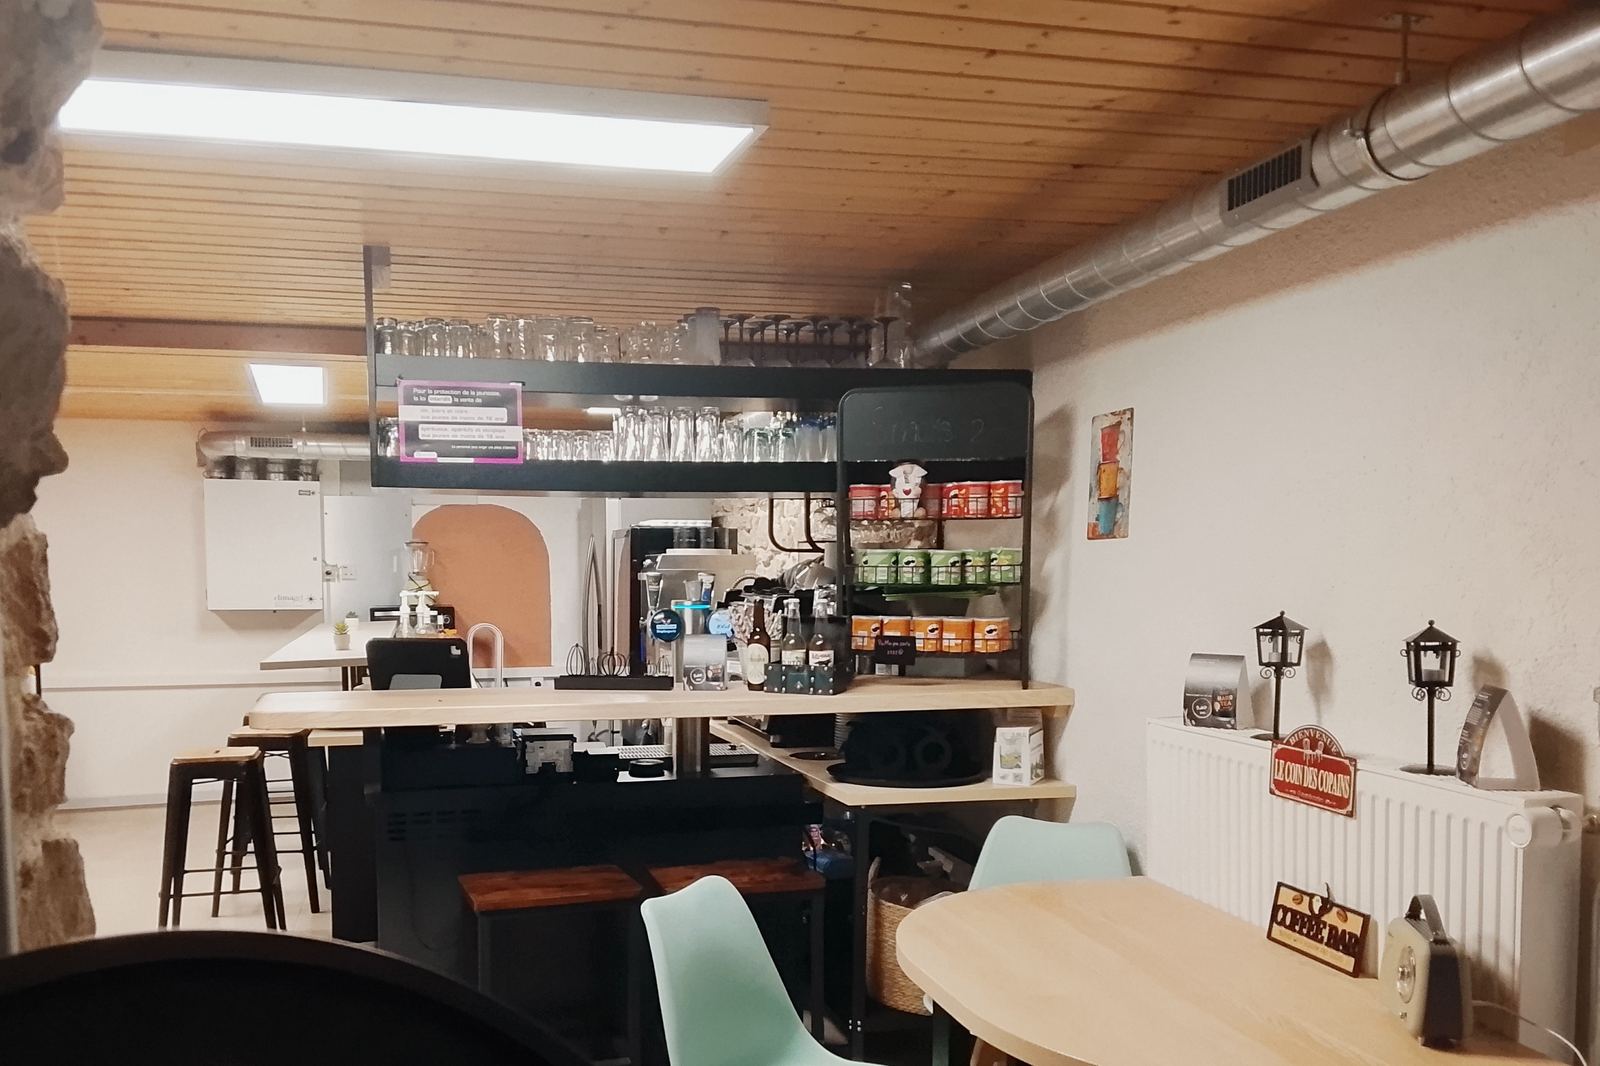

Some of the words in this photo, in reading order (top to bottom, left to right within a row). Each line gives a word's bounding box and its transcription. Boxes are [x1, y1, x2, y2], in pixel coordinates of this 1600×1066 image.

[1289, 729, 1339, 755] BIENVENUE
[1274, 758, 1284, 781] LE
[1285, 761, 1303, 786] COIN
[1303, 765, 1318, 790] DES
[1318, 769, 1350, 799] COPAINS
[1274, 904, 1327, 945] COFFEE
[1324, 924, 1360, 959] BAR
